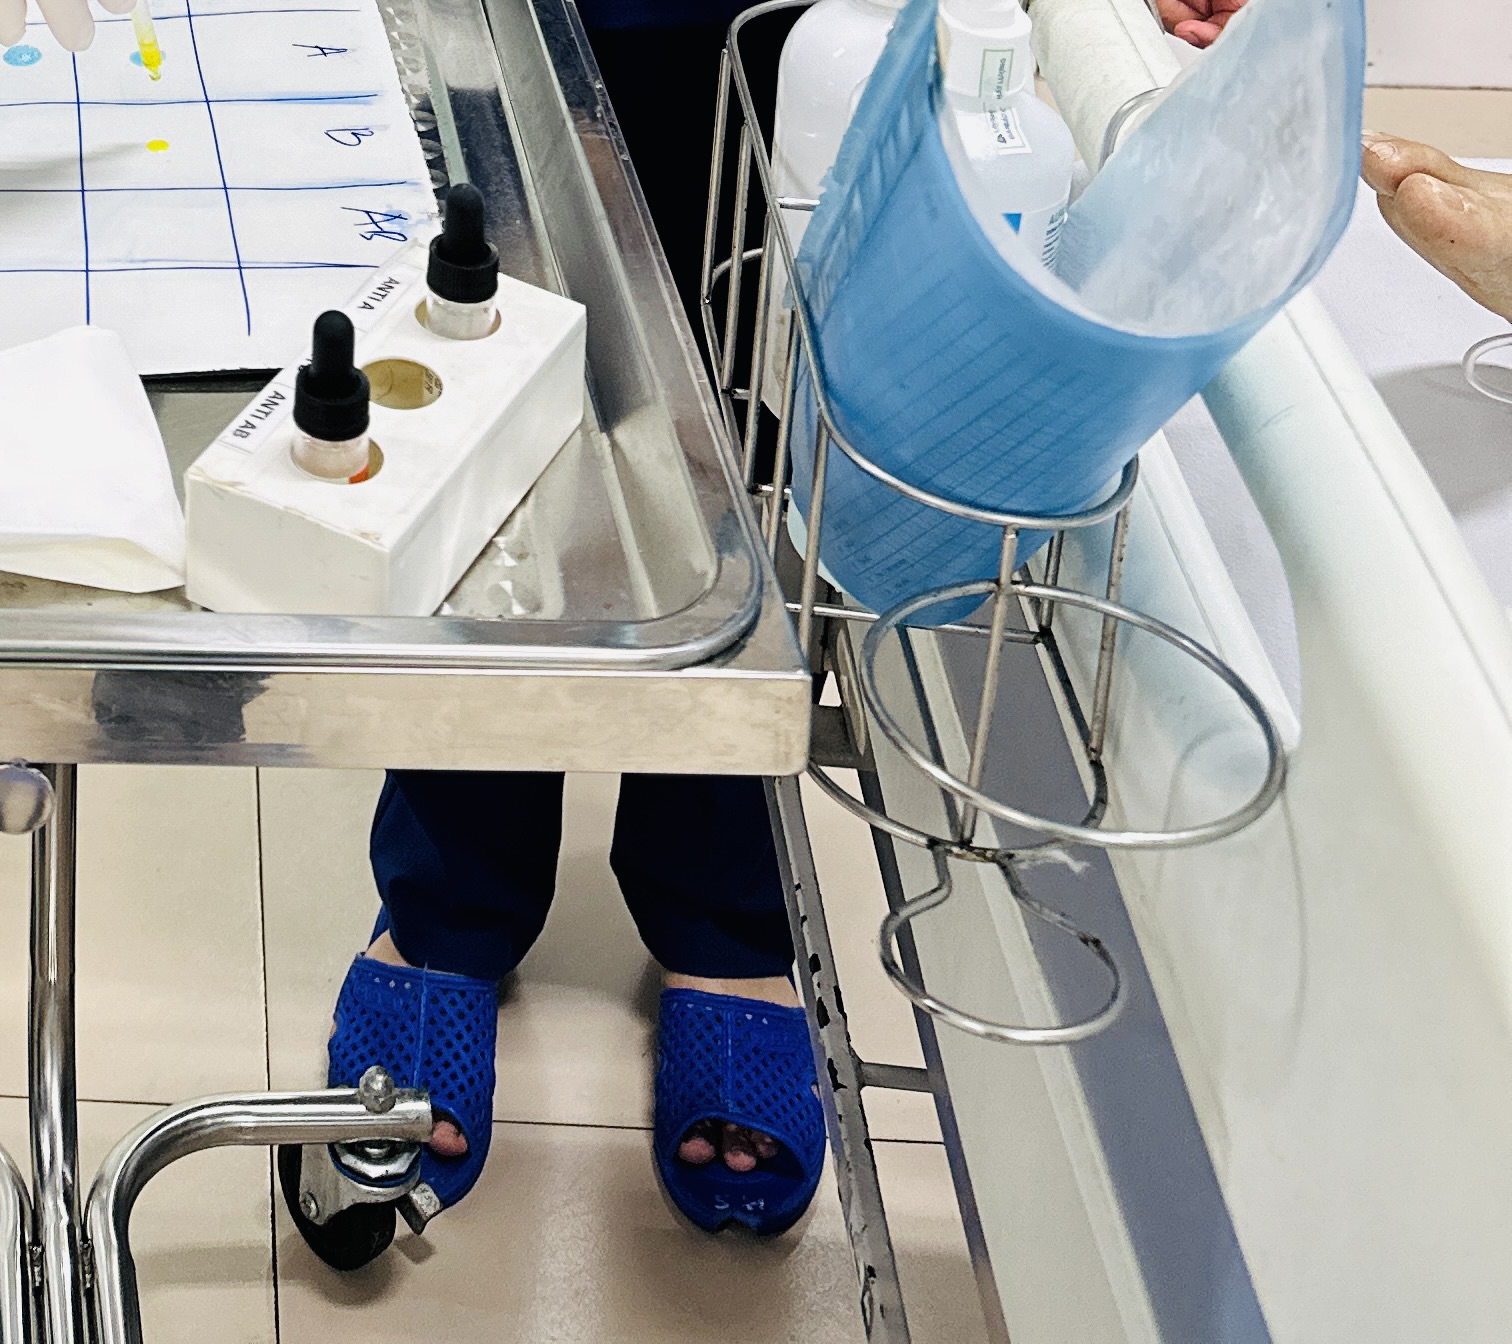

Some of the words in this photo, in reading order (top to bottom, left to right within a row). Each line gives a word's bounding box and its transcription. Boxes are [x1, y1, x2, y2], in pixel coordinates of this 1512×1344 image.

[292, 43, 348, 58] A
[324, 128, 375, 147] B
[367, 277, 400, 302] ANTI
[357, 301, 375, 310] A
[250, 390, 286, 421] ANTI
[232, 419, 257, 439] AB
